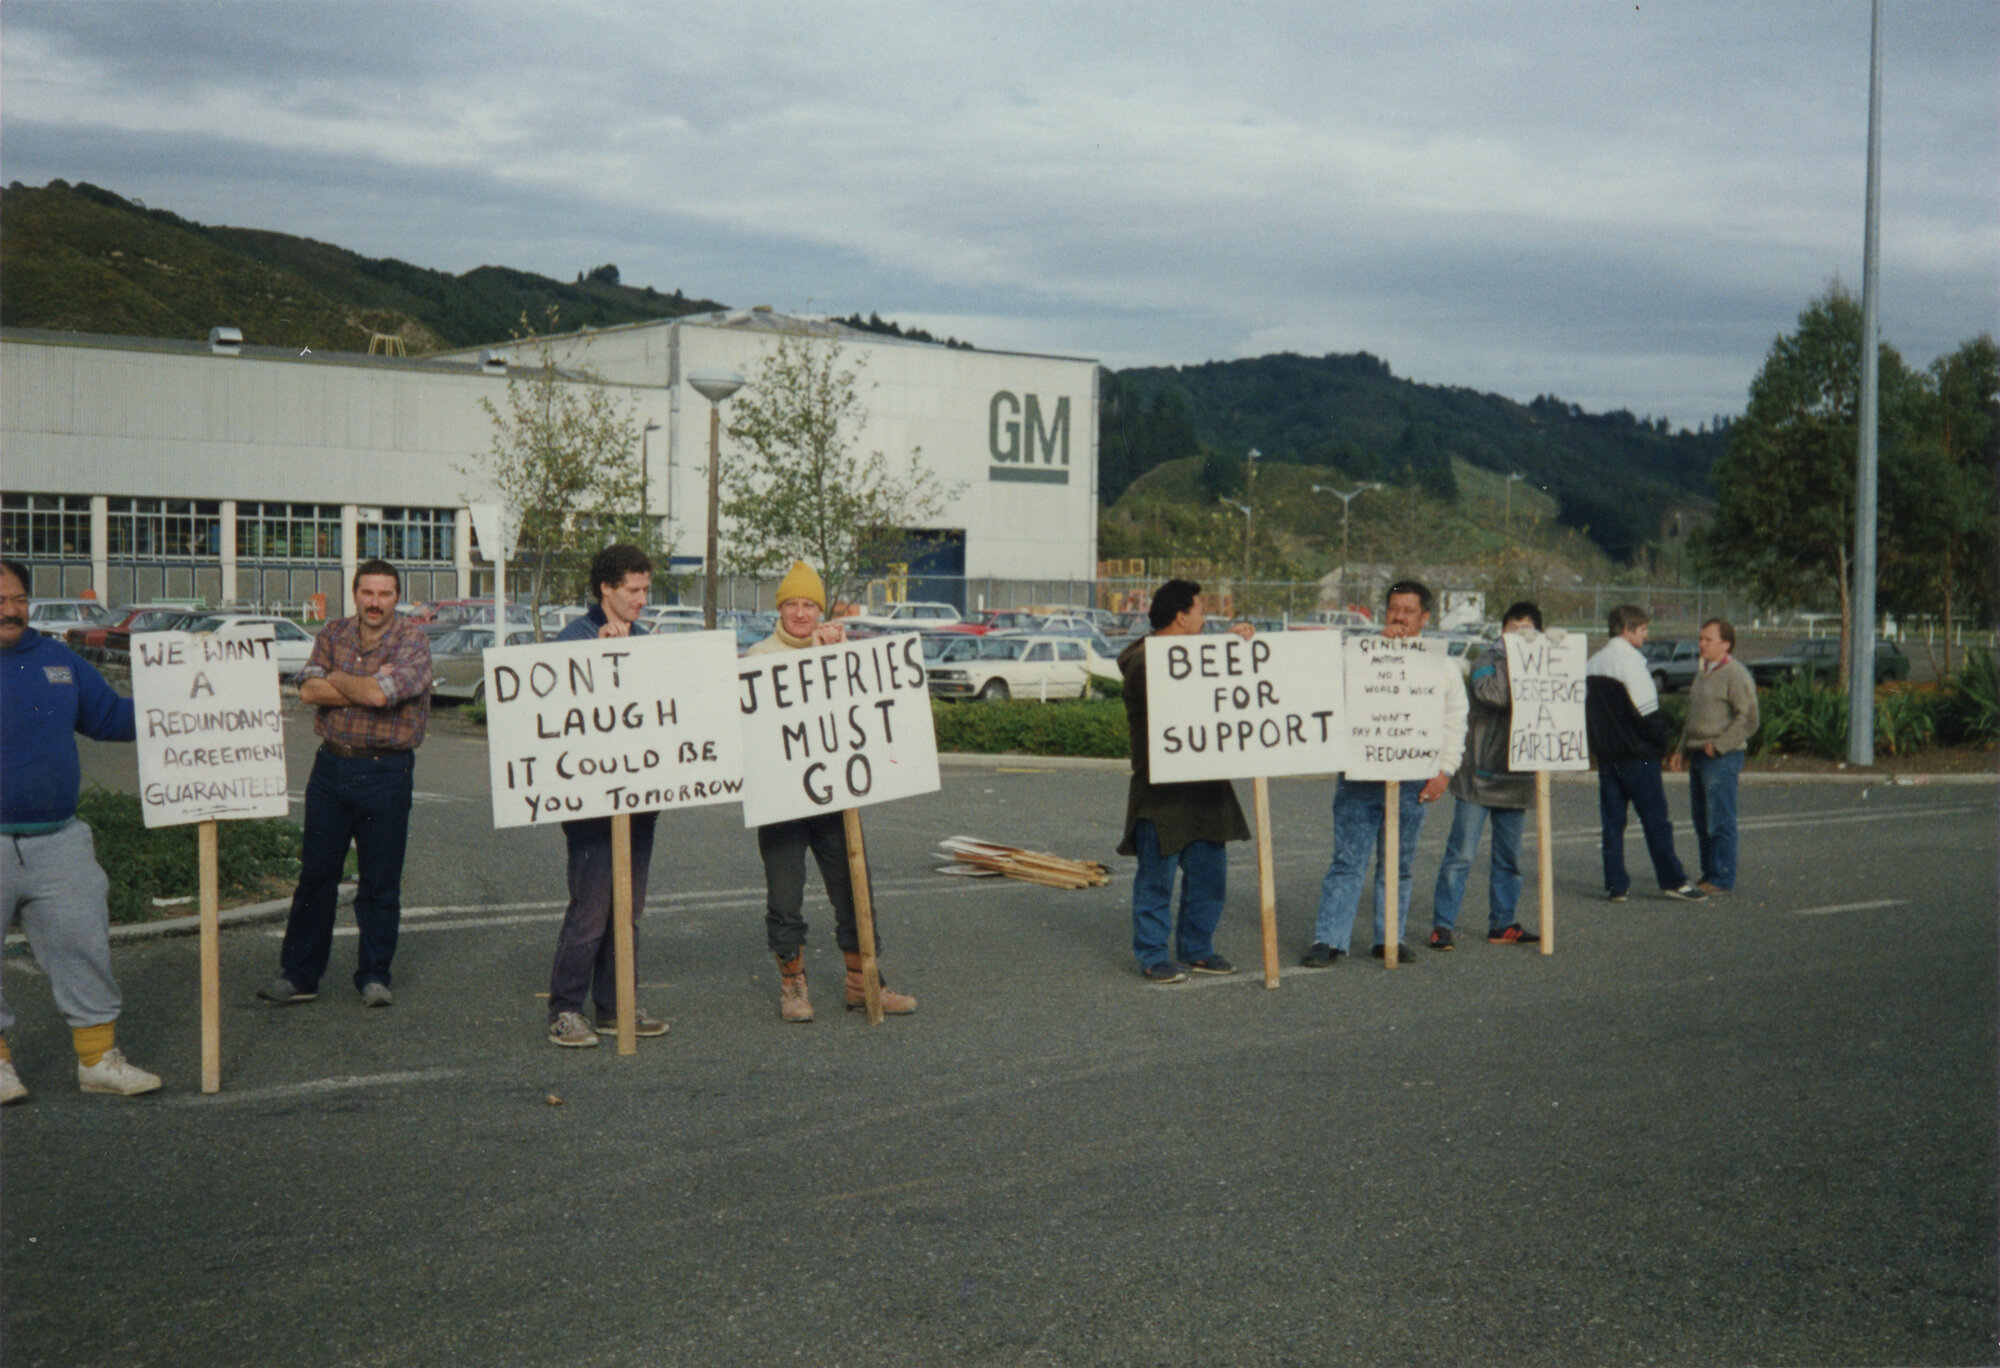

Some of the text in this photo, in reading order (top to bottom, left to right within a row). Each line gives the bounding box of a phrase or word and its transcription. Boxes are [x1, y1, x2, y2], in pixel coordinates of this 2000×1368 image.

[989, 390, 1070, 465] GM
[140, 637, 275, 667] WE WANT
[1167, 640, 1271, 680] BEEP
[1516, 642, 1569, 678] WE
[190, 671, 215, 699] A
[494, 652, 631, 703] DONT
[739, 637, 925, 714] JEFFRIES
[1364, 685, 1400, 695] WORLD
[1512, 679, 1587, 704] DESERVE
[1214, 680, 1280, 713] FOR
[146, 708, 281, 738] REDUNDANCY
[536, 698, 678, 740] LAUGH
[782, 699, 896, 761] MUST
[1163, 710, 1334, 754] SUPPORT
[1375, 726, 1382, 736] A
[1387, 727, 1414, 737] CENT
[1536, 704, 1555, 729] A
[163, 744, 284, 768] AGREEMENT
[507, 741, 719, 789] IT COULD BE
[144, 776, 287, 806] GUARANTEED
[802, 753, 873, 806] GO
